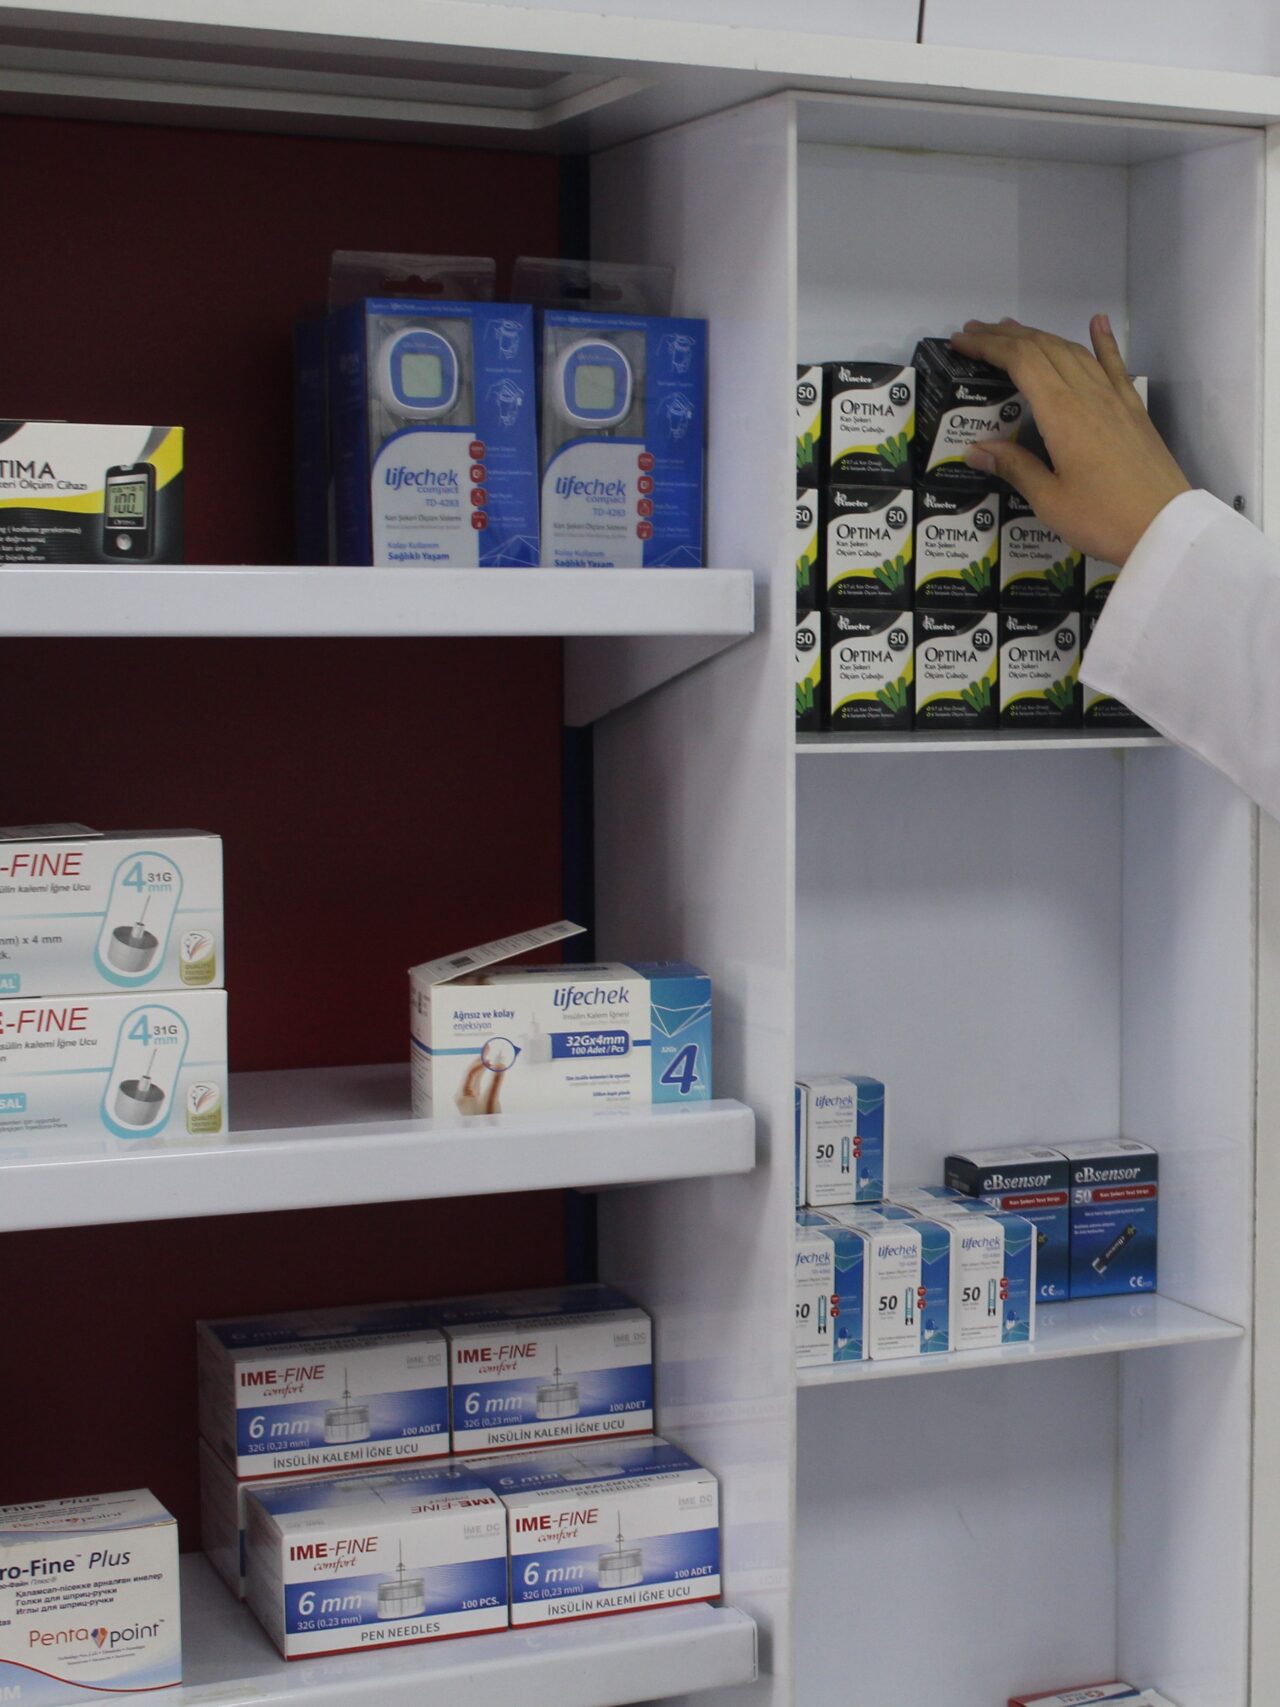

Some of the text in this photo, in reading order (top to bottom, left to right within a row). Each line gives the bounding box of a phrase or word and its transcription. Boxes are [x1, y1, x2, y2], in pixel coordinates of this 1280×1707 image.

[798, 387, 815, 399] 50
[891, 386, 908, 399] 50
[840, 399, 895, 417] OPTIMA
[1003, 406, 1019, 417] 50
[385, 466, 459, 491] lifechek
[555, 475, 626, 500] lifechek
[796, 510, 810, 522] 50
[888, 510, 905, 522] 50
[976, 512, 992, 524] 50
[836, 523, 891, 540] OPTIMA
[925, 525, 979, 542] OPTIMA
[797, 633, 813, 644] 50
[890, 632, 906, 644] 50
[975, 632, 990, 644] 50
[1057, 632, 1073, 644] 50
[840, 647, 893, 663] OPTIMA
[925, 647, 978, 662] OPTIMA
[1008, 647, 1061, 662] OPTIMA
[0, 852, 83, 877] -FINE
[122, 861, 147, 893] 4
[147, 872, 172, 882] 31G
[18, 884, 49, 893] kalemi
[72, 883, 91, 891] Ucu
[147, 884, 172, 892] mm
[32, 935, 39, 944] 4
[42, 936, 62, 944] mm
[553, 986, 629, 1011] lifechek
[453, 1011, 480, 1021] Ağrısız
[493, 1009, 515, 1019] kolay
[128, 1014, 152, 1046] 4
[153, 1025, 178, 1035] 31G
[24, 1040, 55, 1049] kalemi
[79, 1038, 98, 1046] Ucu
[154, 1036, 178, 1045] mm
[566, 1035, 626, 1047] 32Gx4mm
[571, 1045, 624, 1055] 100 Adet Pcs
[660, 1043, 699, 1095] 4
[815, 1095, 853, 1109] lifechek
[816, 1144, 834, 1159] 50
[983, 1174, 1051, 1190] eBsensor
[1074, 1166, 1141, 1183] eBsensor
[1074, 1189, 1092, 1204] 50
[961, 1236, 1000, 1251] lifechek
[878, 1244, 917, 1259] lifechek
[961, 1286, 981, 1302] 50
[878, 1295, 898, 1311] 50
[457, 1342, 537, 1363] IME-FINE
[478, 1360, 518, 1375] comfort
[241, 1364, 325, 1387] IME-FINE
[263, 1382, 305, 1398] comfort
[465, 1392, 523, 1414] 6 mm
[609, 1401, 645, 1412] 100 ADET
[248, 1416, 310, 1439] 6 mm
[464, 1419, 479, 1428] 32G
[503, 1414, 522, 1424] mm)
[402, 1424, 441, 1437] 100 ADET
[487, 1419, 625, 1444] İNSÜLİN KALEMİ İĞNE UCU
[248, 1443, 265, 1453] 32G
[289, 1438, 310, 1449] mm)
[273, 1444, 419, 1469] İNSÜLİN KALEMİ İĞNE UCU
[515, 1508, 599, 1533] IME-FINE
[538, 1528, 578, 1544] comfort
[290, 1536, 379, 1561] IME-FINE
[88, 1549, 131, 1569] Plus
[313, 1555, 357, 1573] comfort
[523, 1562, 584, 1585] 6 mm
[674, 1566, 713, 1579] 100 ADET
[522, 1590, 539, 1600] 32G
[563, 1583, 584, 1594] mm)
[44, 1595, 61, 1604] для
[298, 1591, 362, 1615] 6 mm
[461, 1596, 500, 1609] 100 PCS.
[548, 1586, 691, 1616] İNSÜLİN KALEMİ İĞNE UCU
[41, 1604, 58, 1613] для
[297, 1620, 315, 1631] 32G
[341, 1614, 362, 1625] mm)
[29, 1622, 159, 1648] Penta point
[361, 1622, 440, 1641] PEN NEEDLES
